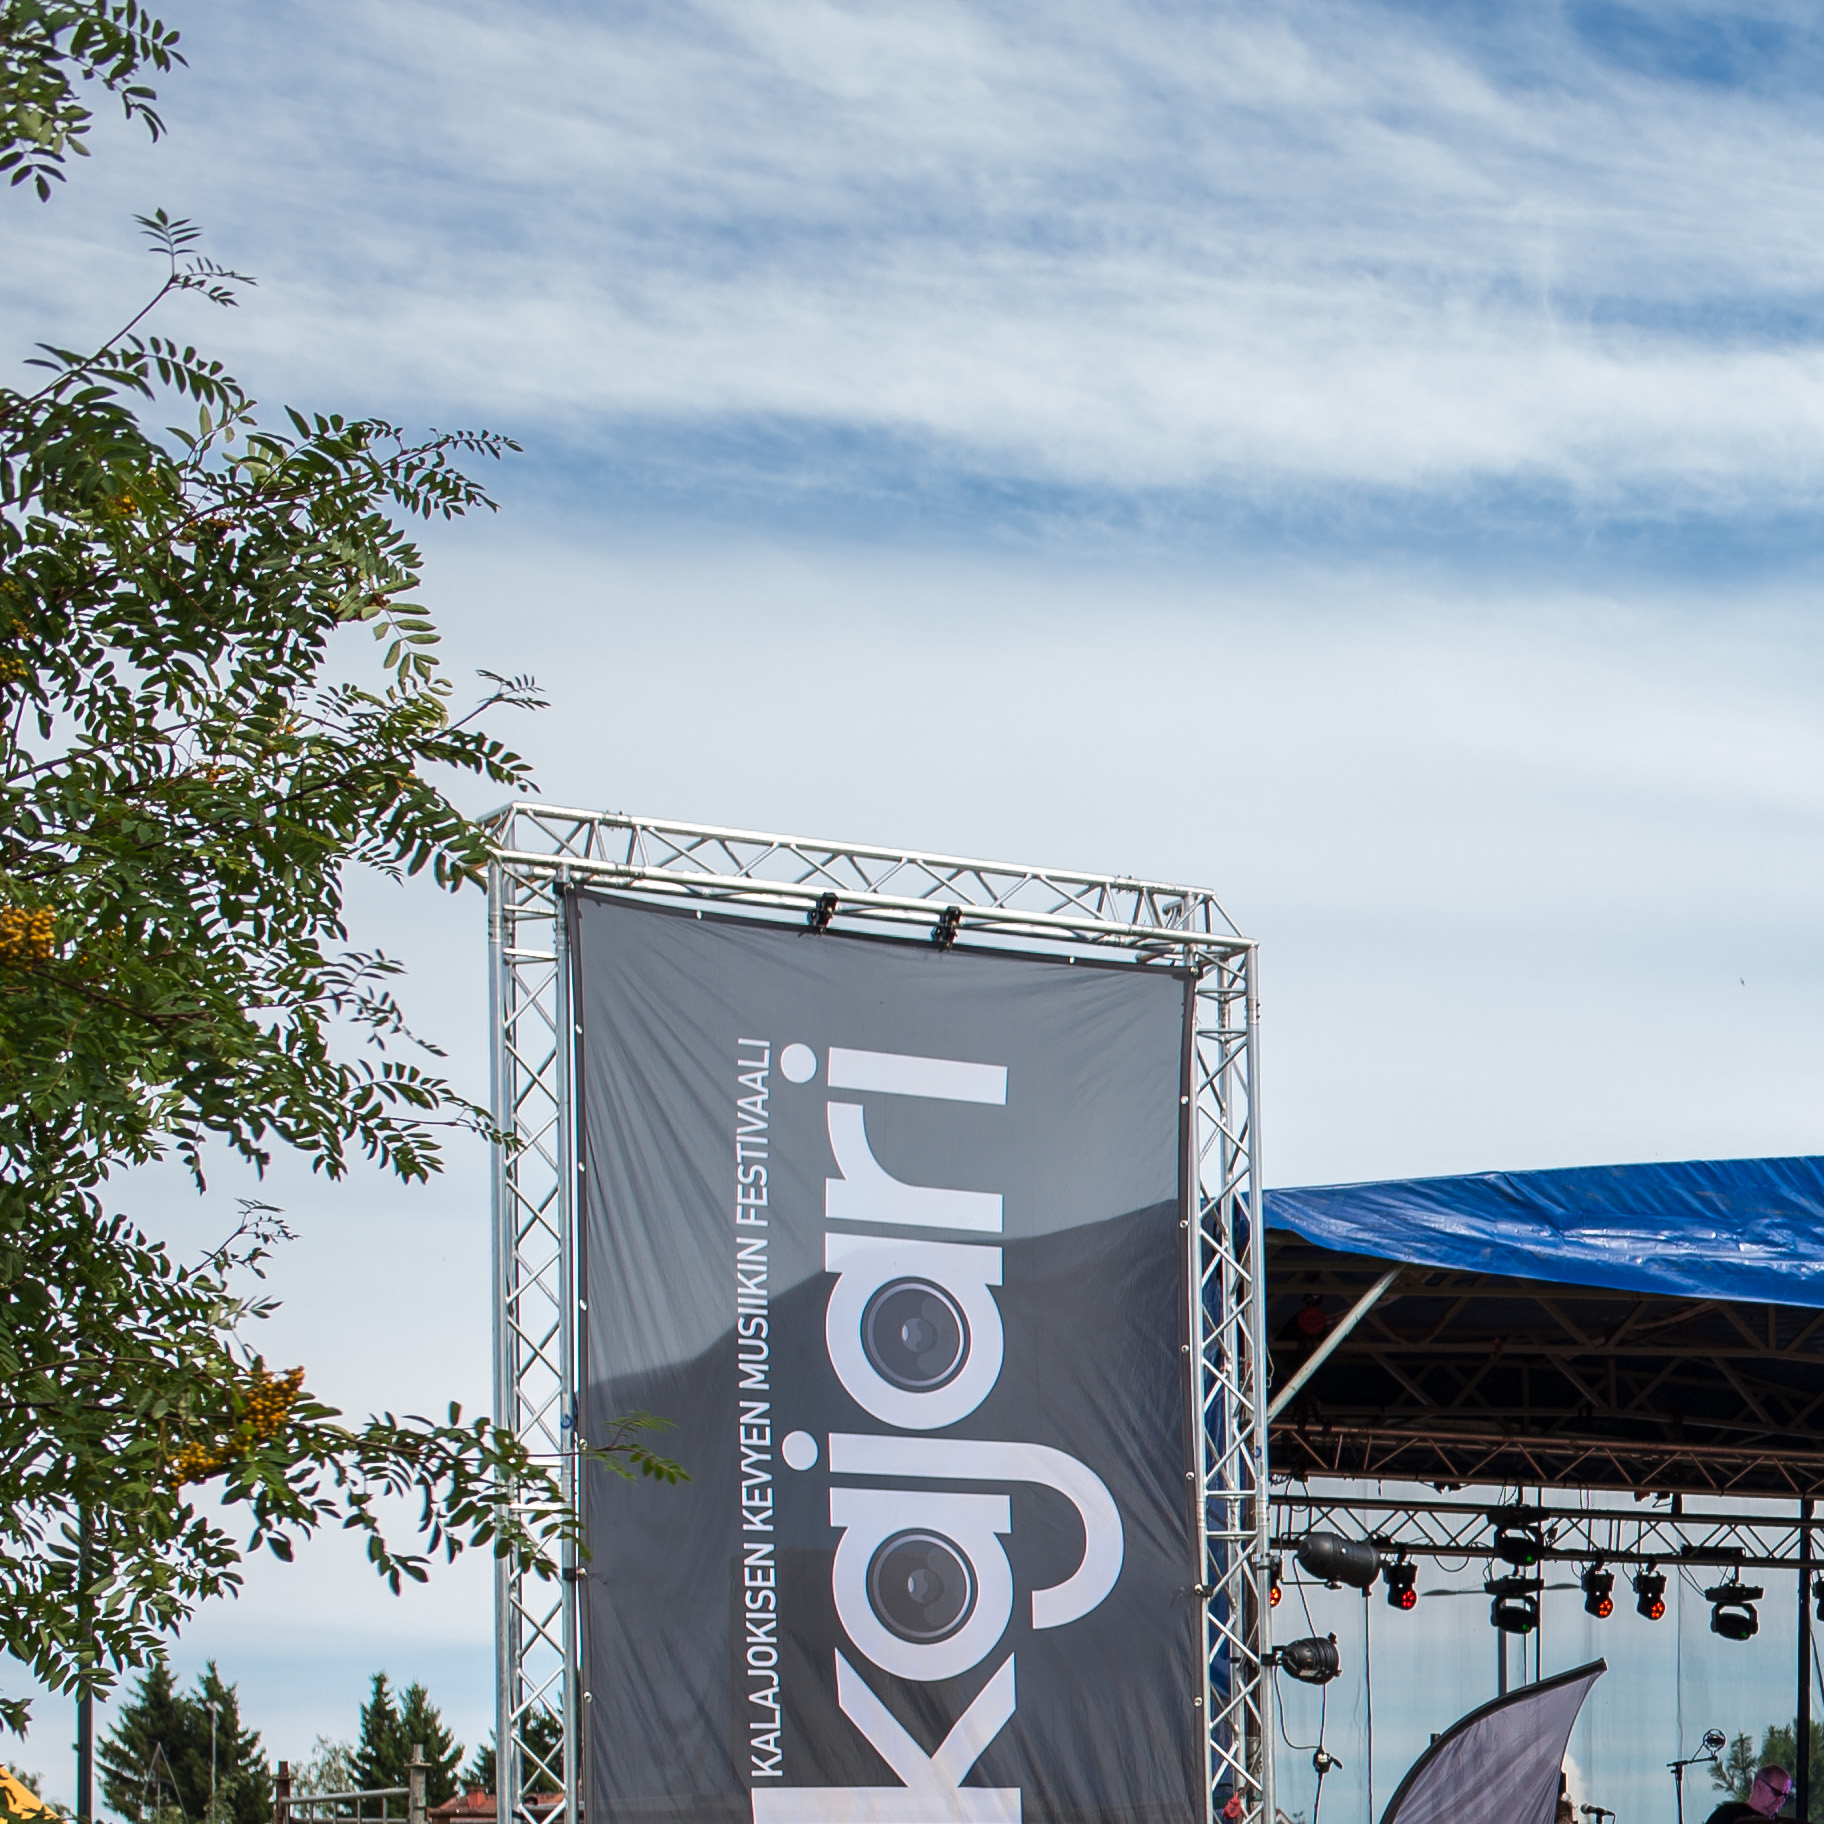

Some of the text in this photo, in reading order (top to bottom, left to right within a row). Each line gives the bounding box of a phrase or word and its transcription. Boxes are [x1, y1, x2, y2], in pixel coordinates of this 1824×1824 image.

[736, 1038, 783, 1777] KALAJOKISEN KEVYEN MUSIIKIN FESTIVAALI
